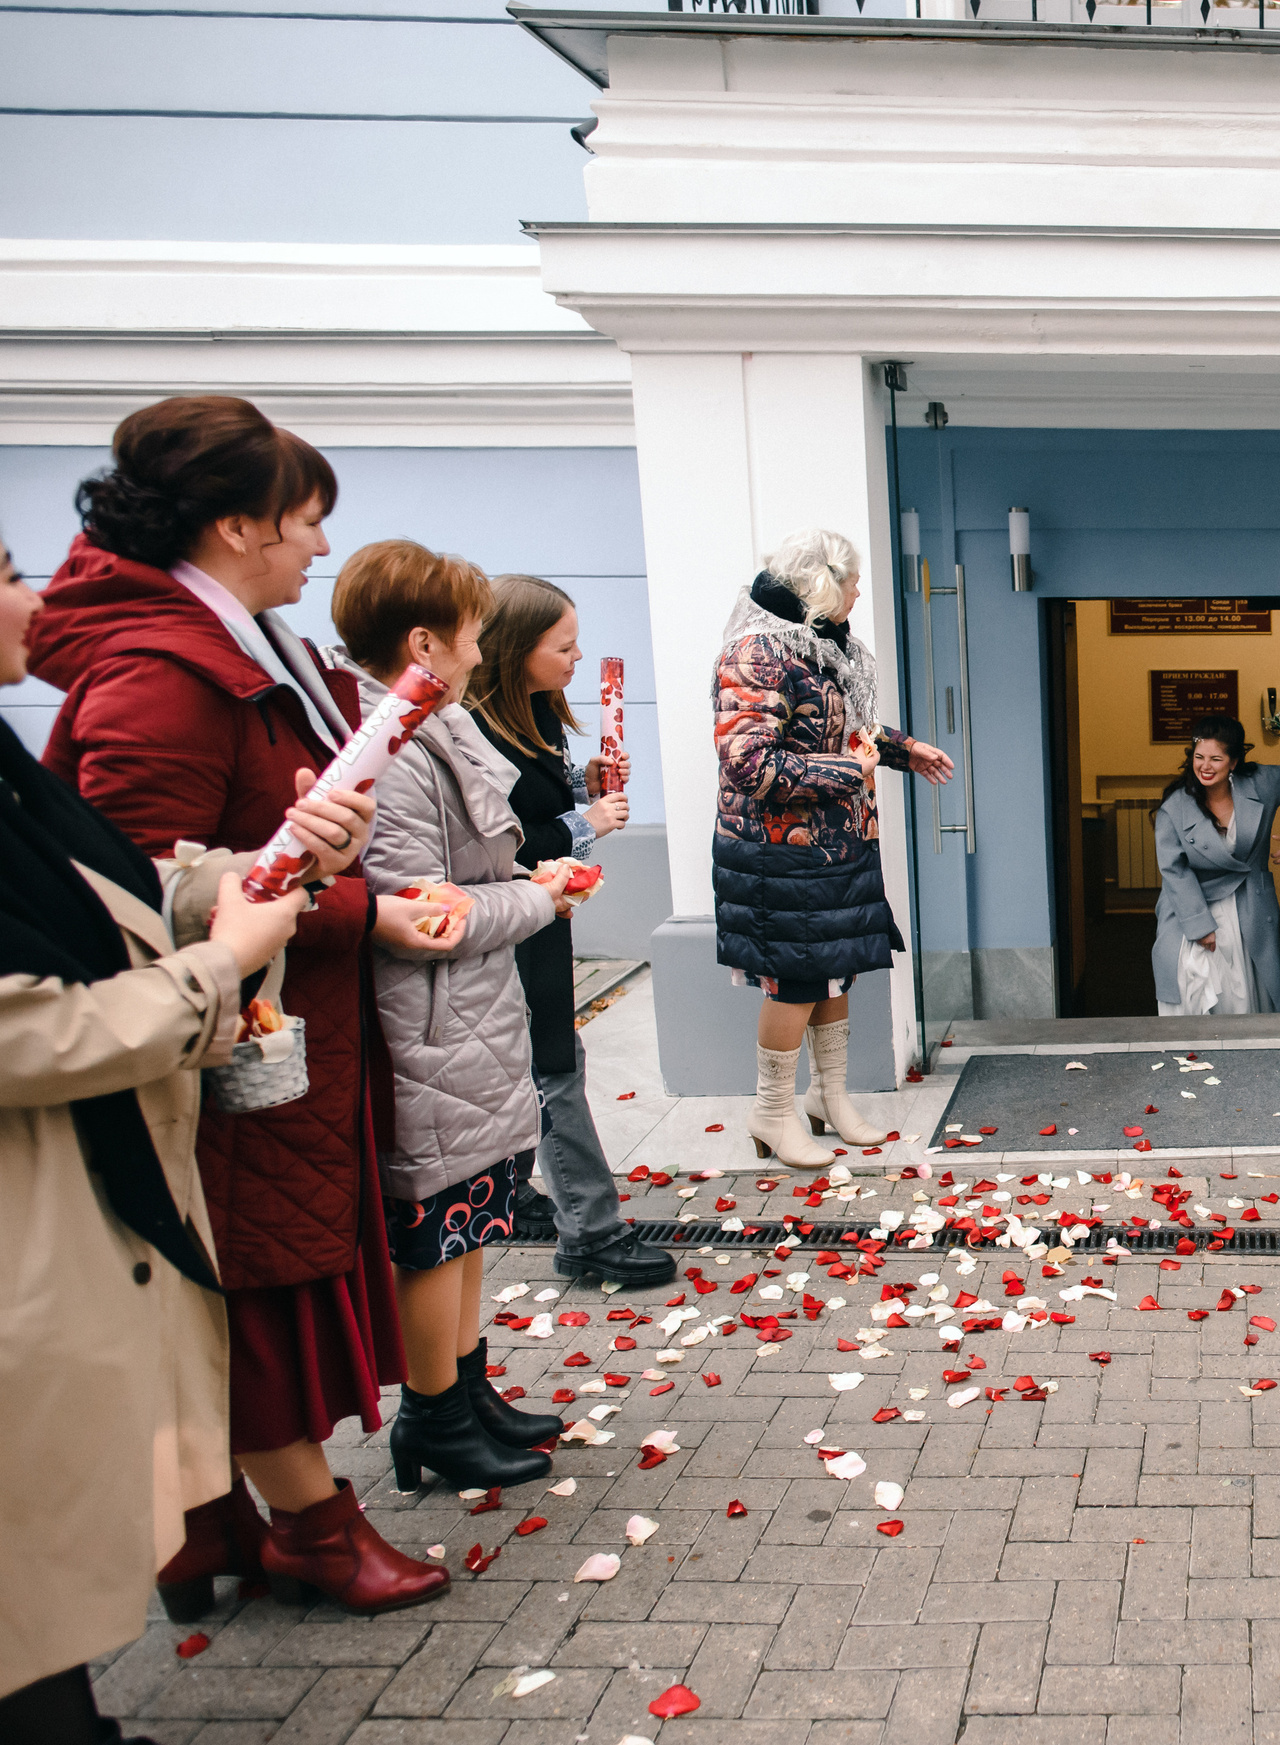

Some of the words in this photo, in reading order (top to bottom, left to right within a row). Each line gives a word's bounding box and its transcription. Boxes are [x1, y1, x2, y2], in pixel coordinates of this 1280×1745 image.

[1162, 672, 1189, 680] ПРИЕМ
[1209, 692, 1229, 700] 17.00
[258, 693, 402, 866] ХЛПУШКА
